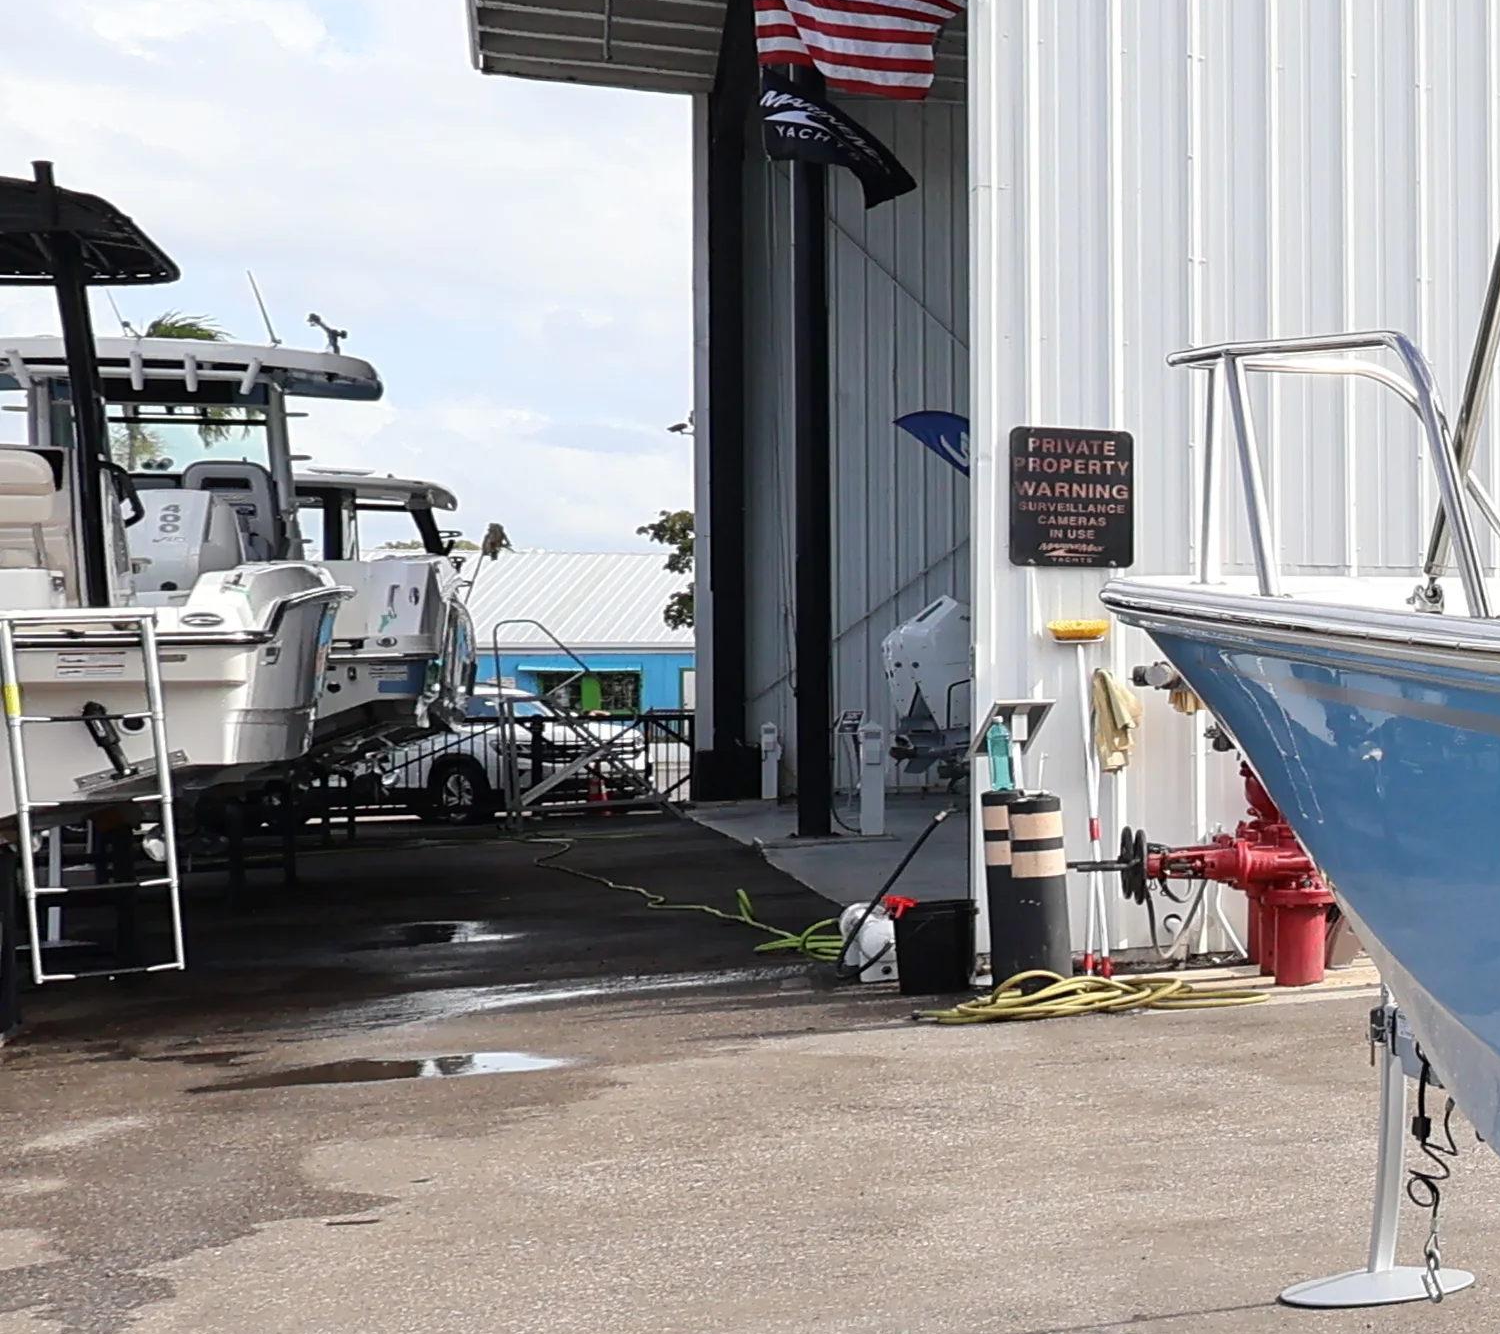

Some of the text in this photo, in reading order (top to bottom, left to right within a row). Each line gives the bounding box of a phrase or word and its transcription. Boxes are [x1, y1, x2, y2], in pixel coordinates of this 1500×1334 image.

[1028, 438, 1116, 456] PRIVATE
[1014, 457, 1129, 476] PROPERTY
[1017, 481, 1129, 500] WARNING
[1019, 501, 1126, 514] SURVEILLANCE
[1038, 516, 1107, 527] CAMERAS
[1050, 529, 1095, 540] IN USE
